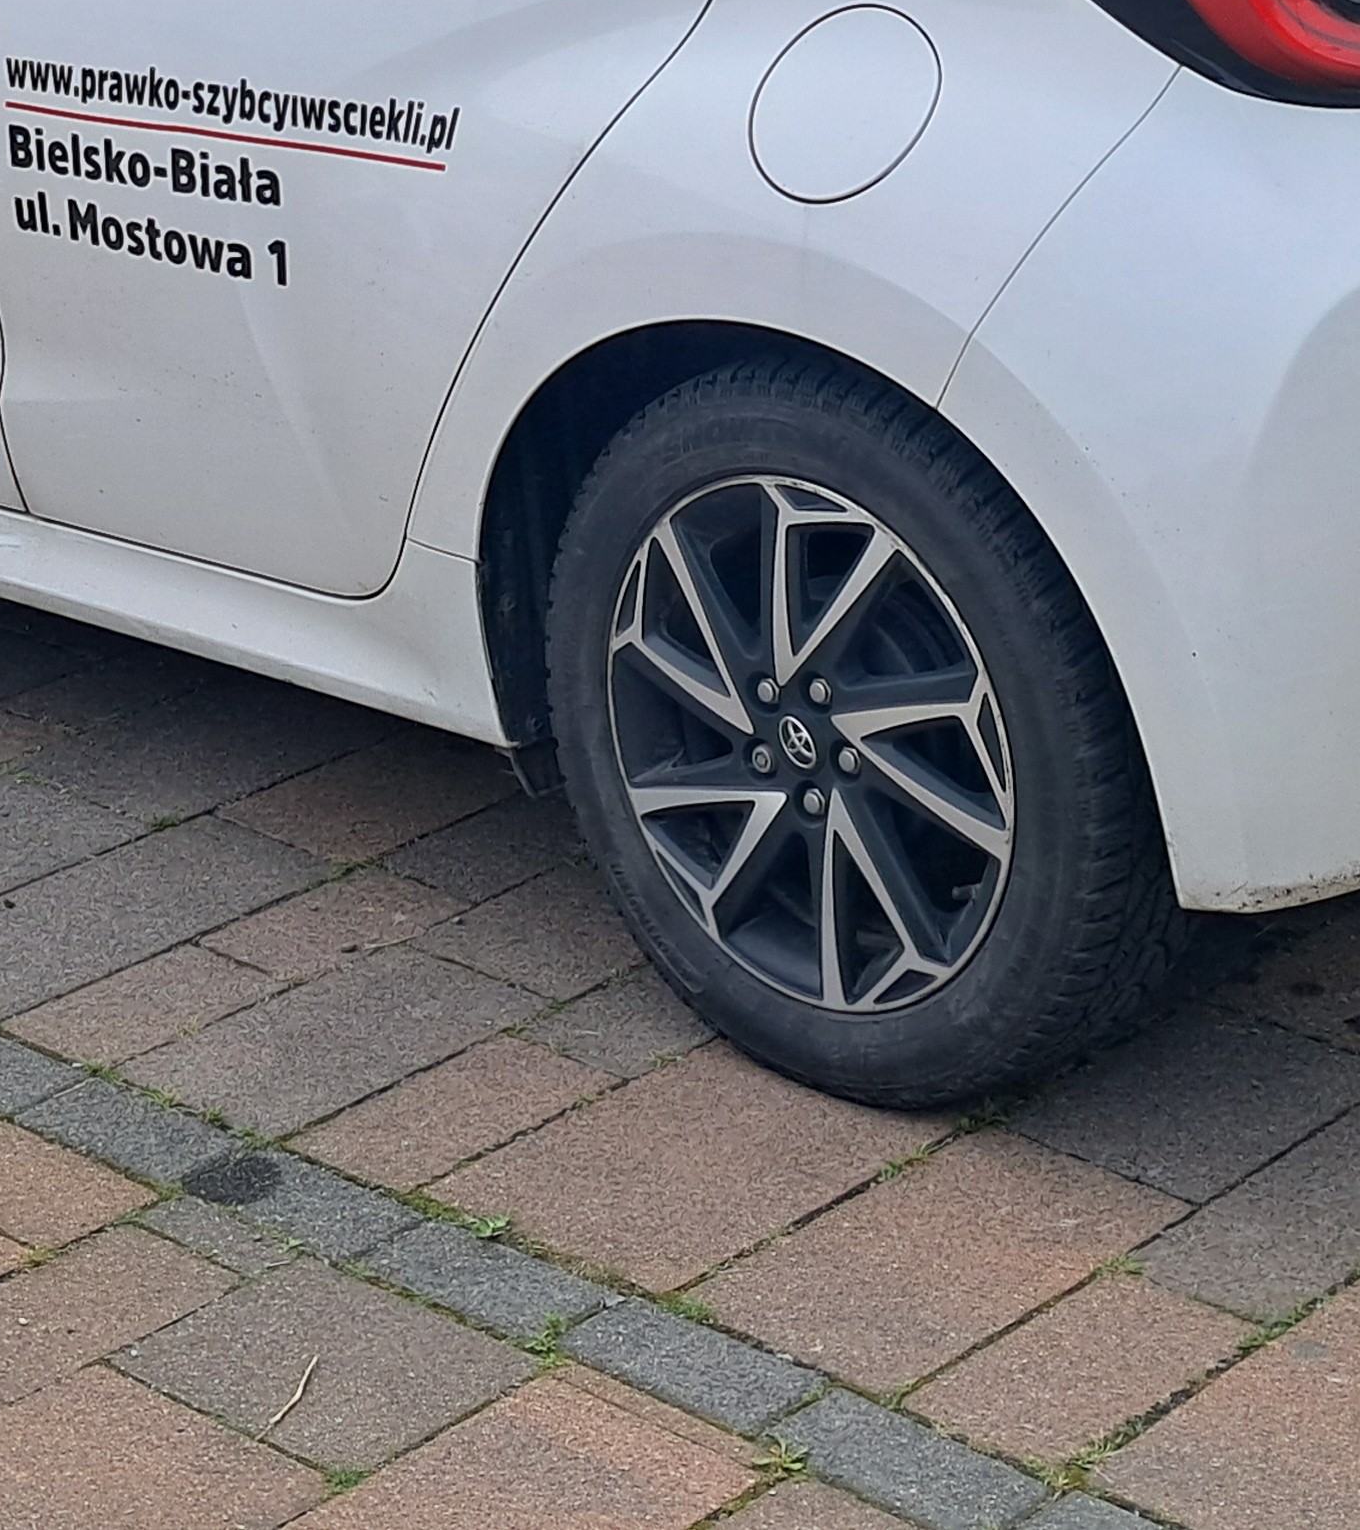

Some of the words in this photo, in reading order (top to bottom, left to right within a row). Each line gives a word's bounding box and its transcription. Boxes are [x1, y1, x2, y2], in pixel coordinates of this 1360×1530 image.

[8, 124, 281, 207] Bielsko-Biała
[14, 192, 62, 237] ul.
[67, 198, 252, 280] Mostowa
[267, 239, 288, 287] 1
